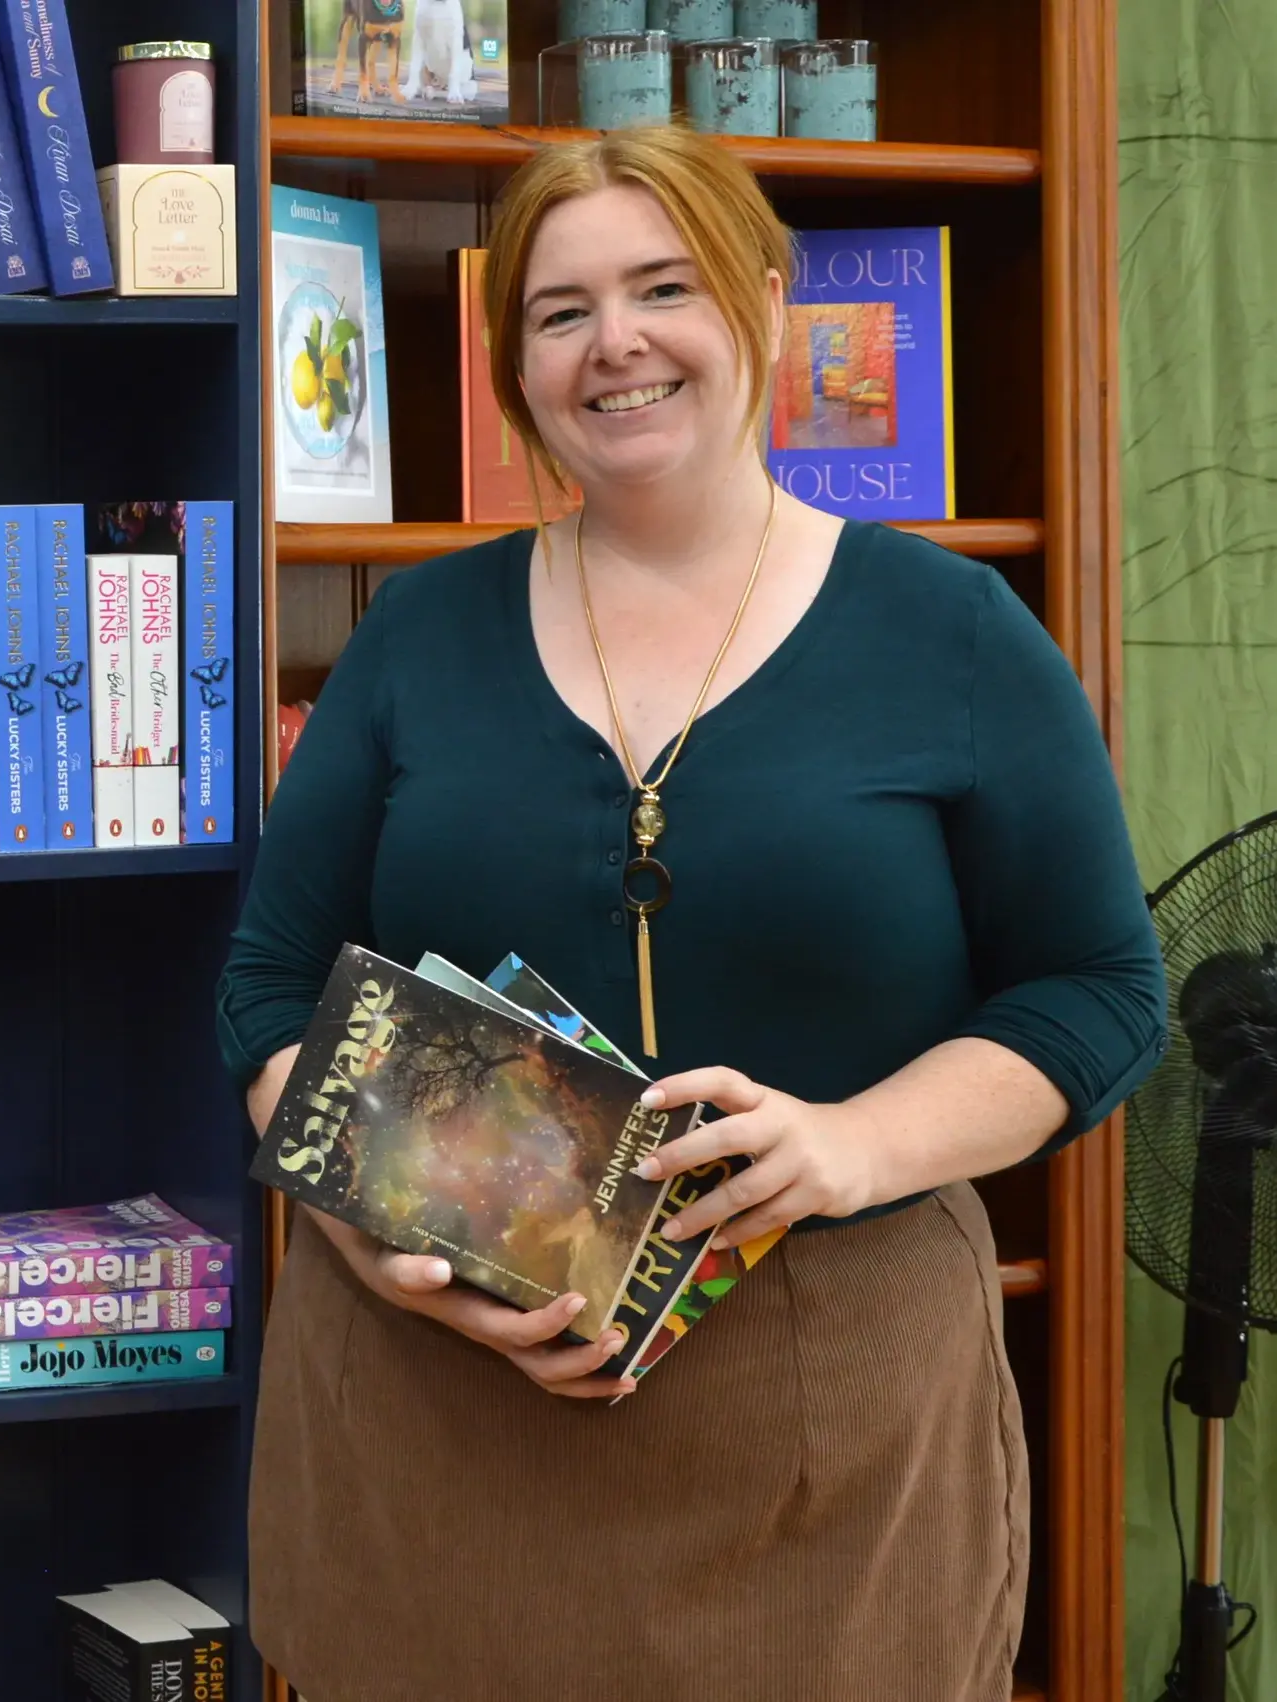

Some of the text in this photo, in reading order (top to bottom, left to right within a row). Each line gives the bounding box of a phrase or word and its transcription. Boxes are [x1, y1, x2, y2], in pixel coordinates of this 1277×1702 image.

[158, 212, 198, 224] Letter
[161, 199, 194, 211] Love
[290, 200, 341, 229] donna hay
[98, 570, 117, 645] JOHNS
[116, 575, 128, 641] RACHAEL
[142, 570, 160, 645] JOHNS
[160, 575, 172, 642] RACHAEL
[8, 717, 21, 815] LUCKY SISTERS
[55, 715, 69, 812] LUCKY SISTERS
[200, 711, 211, 807] LUCKY SISTERS
[277, 979, 395, 1185] Salvage
[593, 1101, 651, 1214] JENNIFER
[629, 1110, 669, 1177] MILLS
[21, 1340, 182, 1377] Jojo Moyes
[152, 1661, 164, 1692] THE
[195, 1648, 208, 1665] IN
[209, 1641, 224, 1702] A GENT
